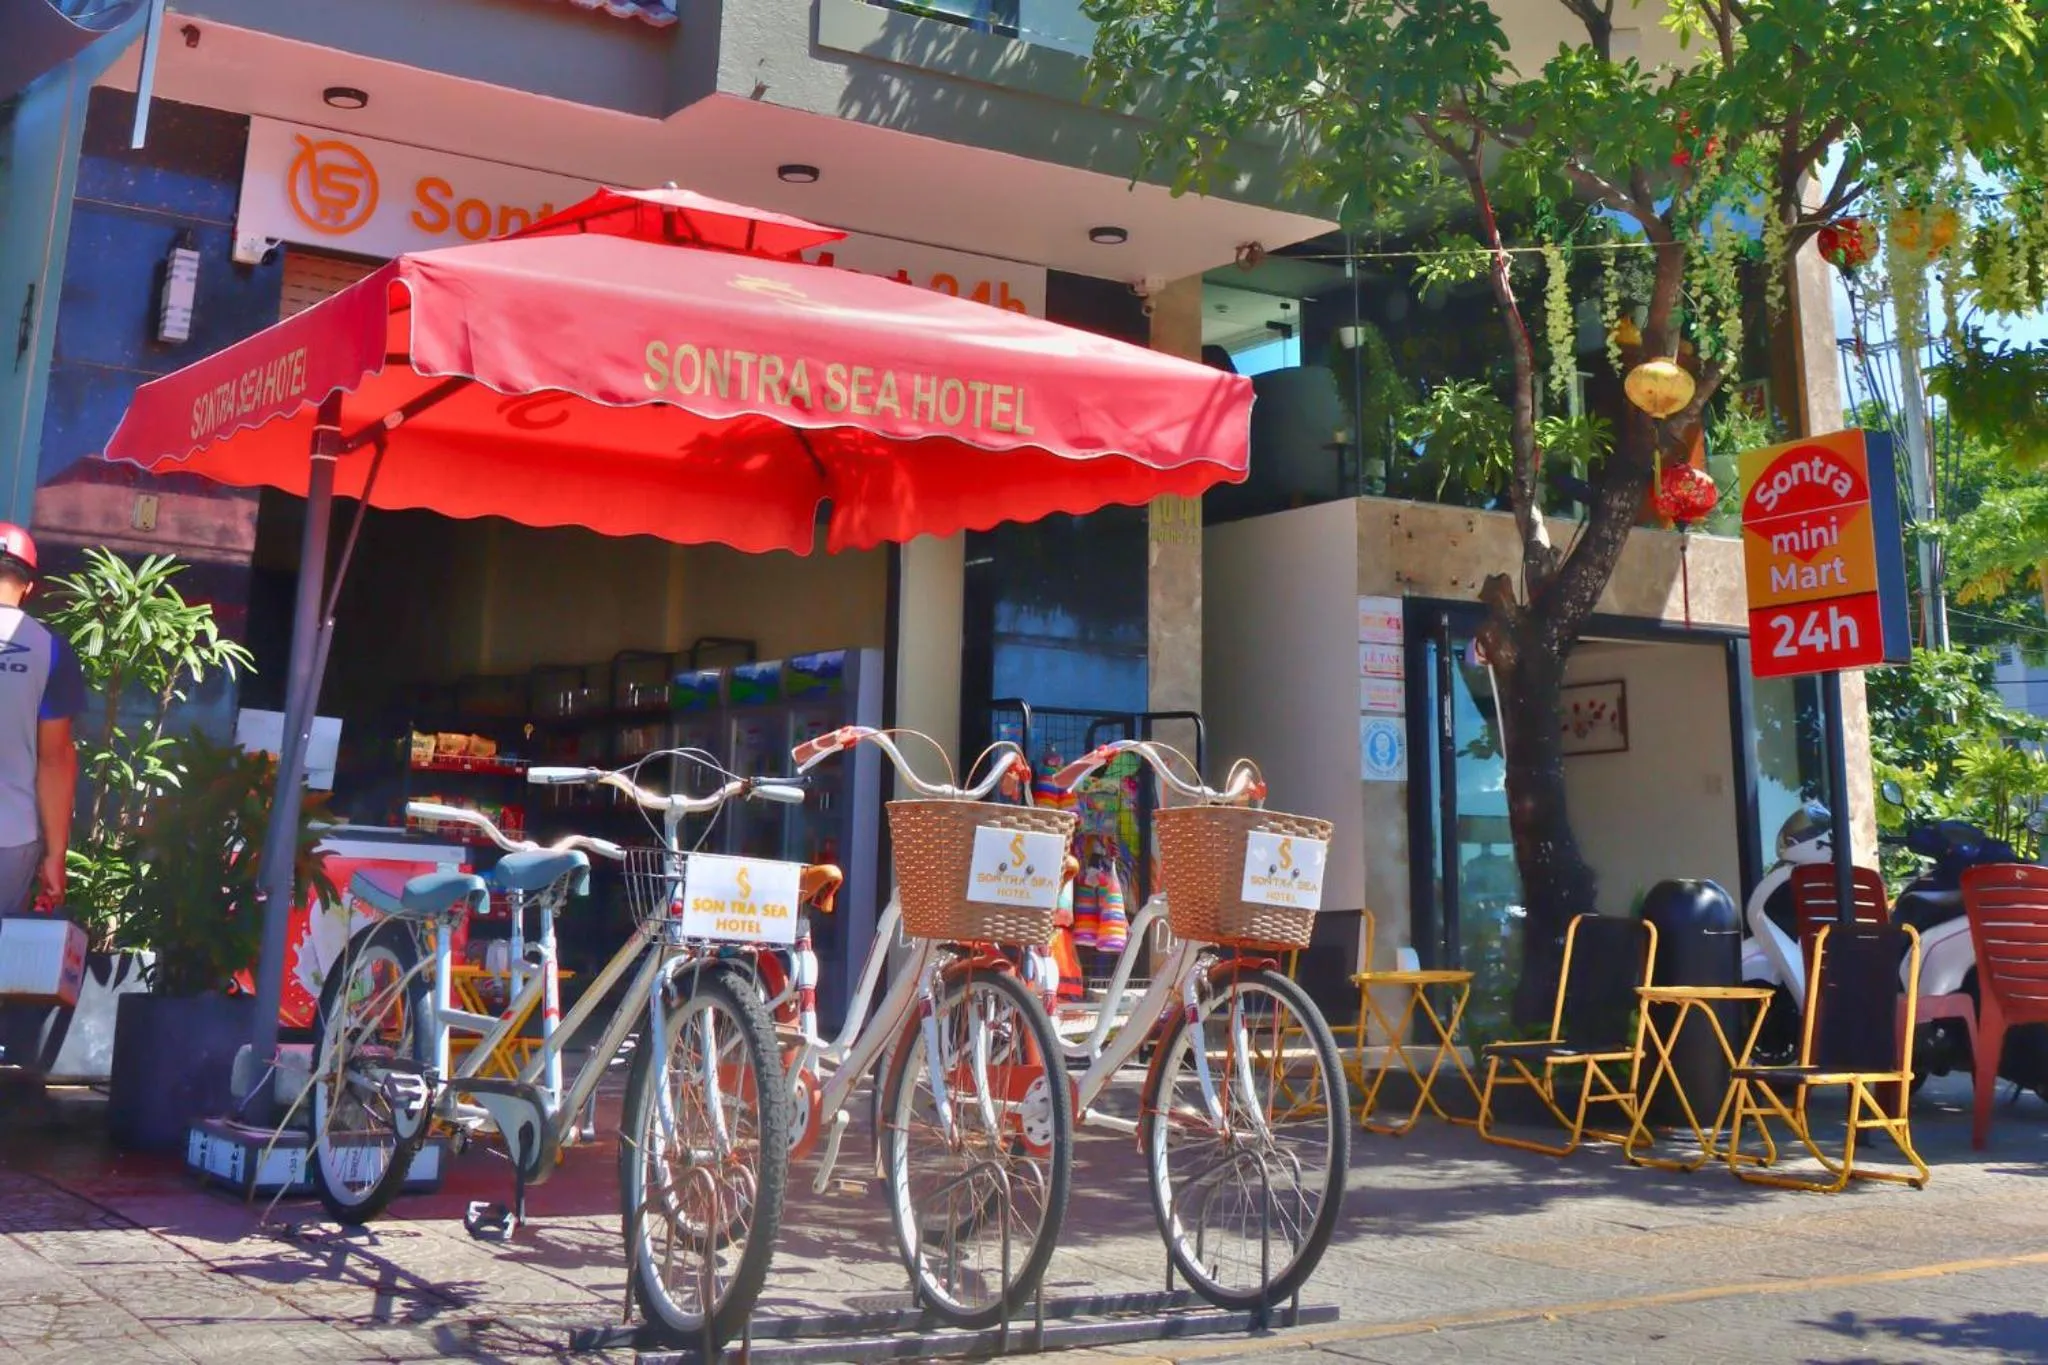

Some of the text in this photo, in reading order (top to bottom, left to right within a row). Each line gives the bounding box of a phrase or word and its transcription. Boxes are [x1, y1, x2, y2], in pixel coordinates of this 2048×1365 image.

[190, 346, 307, 440] SONTRA SEA HOTEL
[643, 340, 1035, 436] SONTRA SEA HOTEL
[1772, 516, 1839, 555] mini
[1770, 556, 1848, 593] Mart
[1769, 606, 1860, 657] 24h
[692, 898, 788, 918] SON TRA SEA
[716, 918, 762, 933] HOTEL
